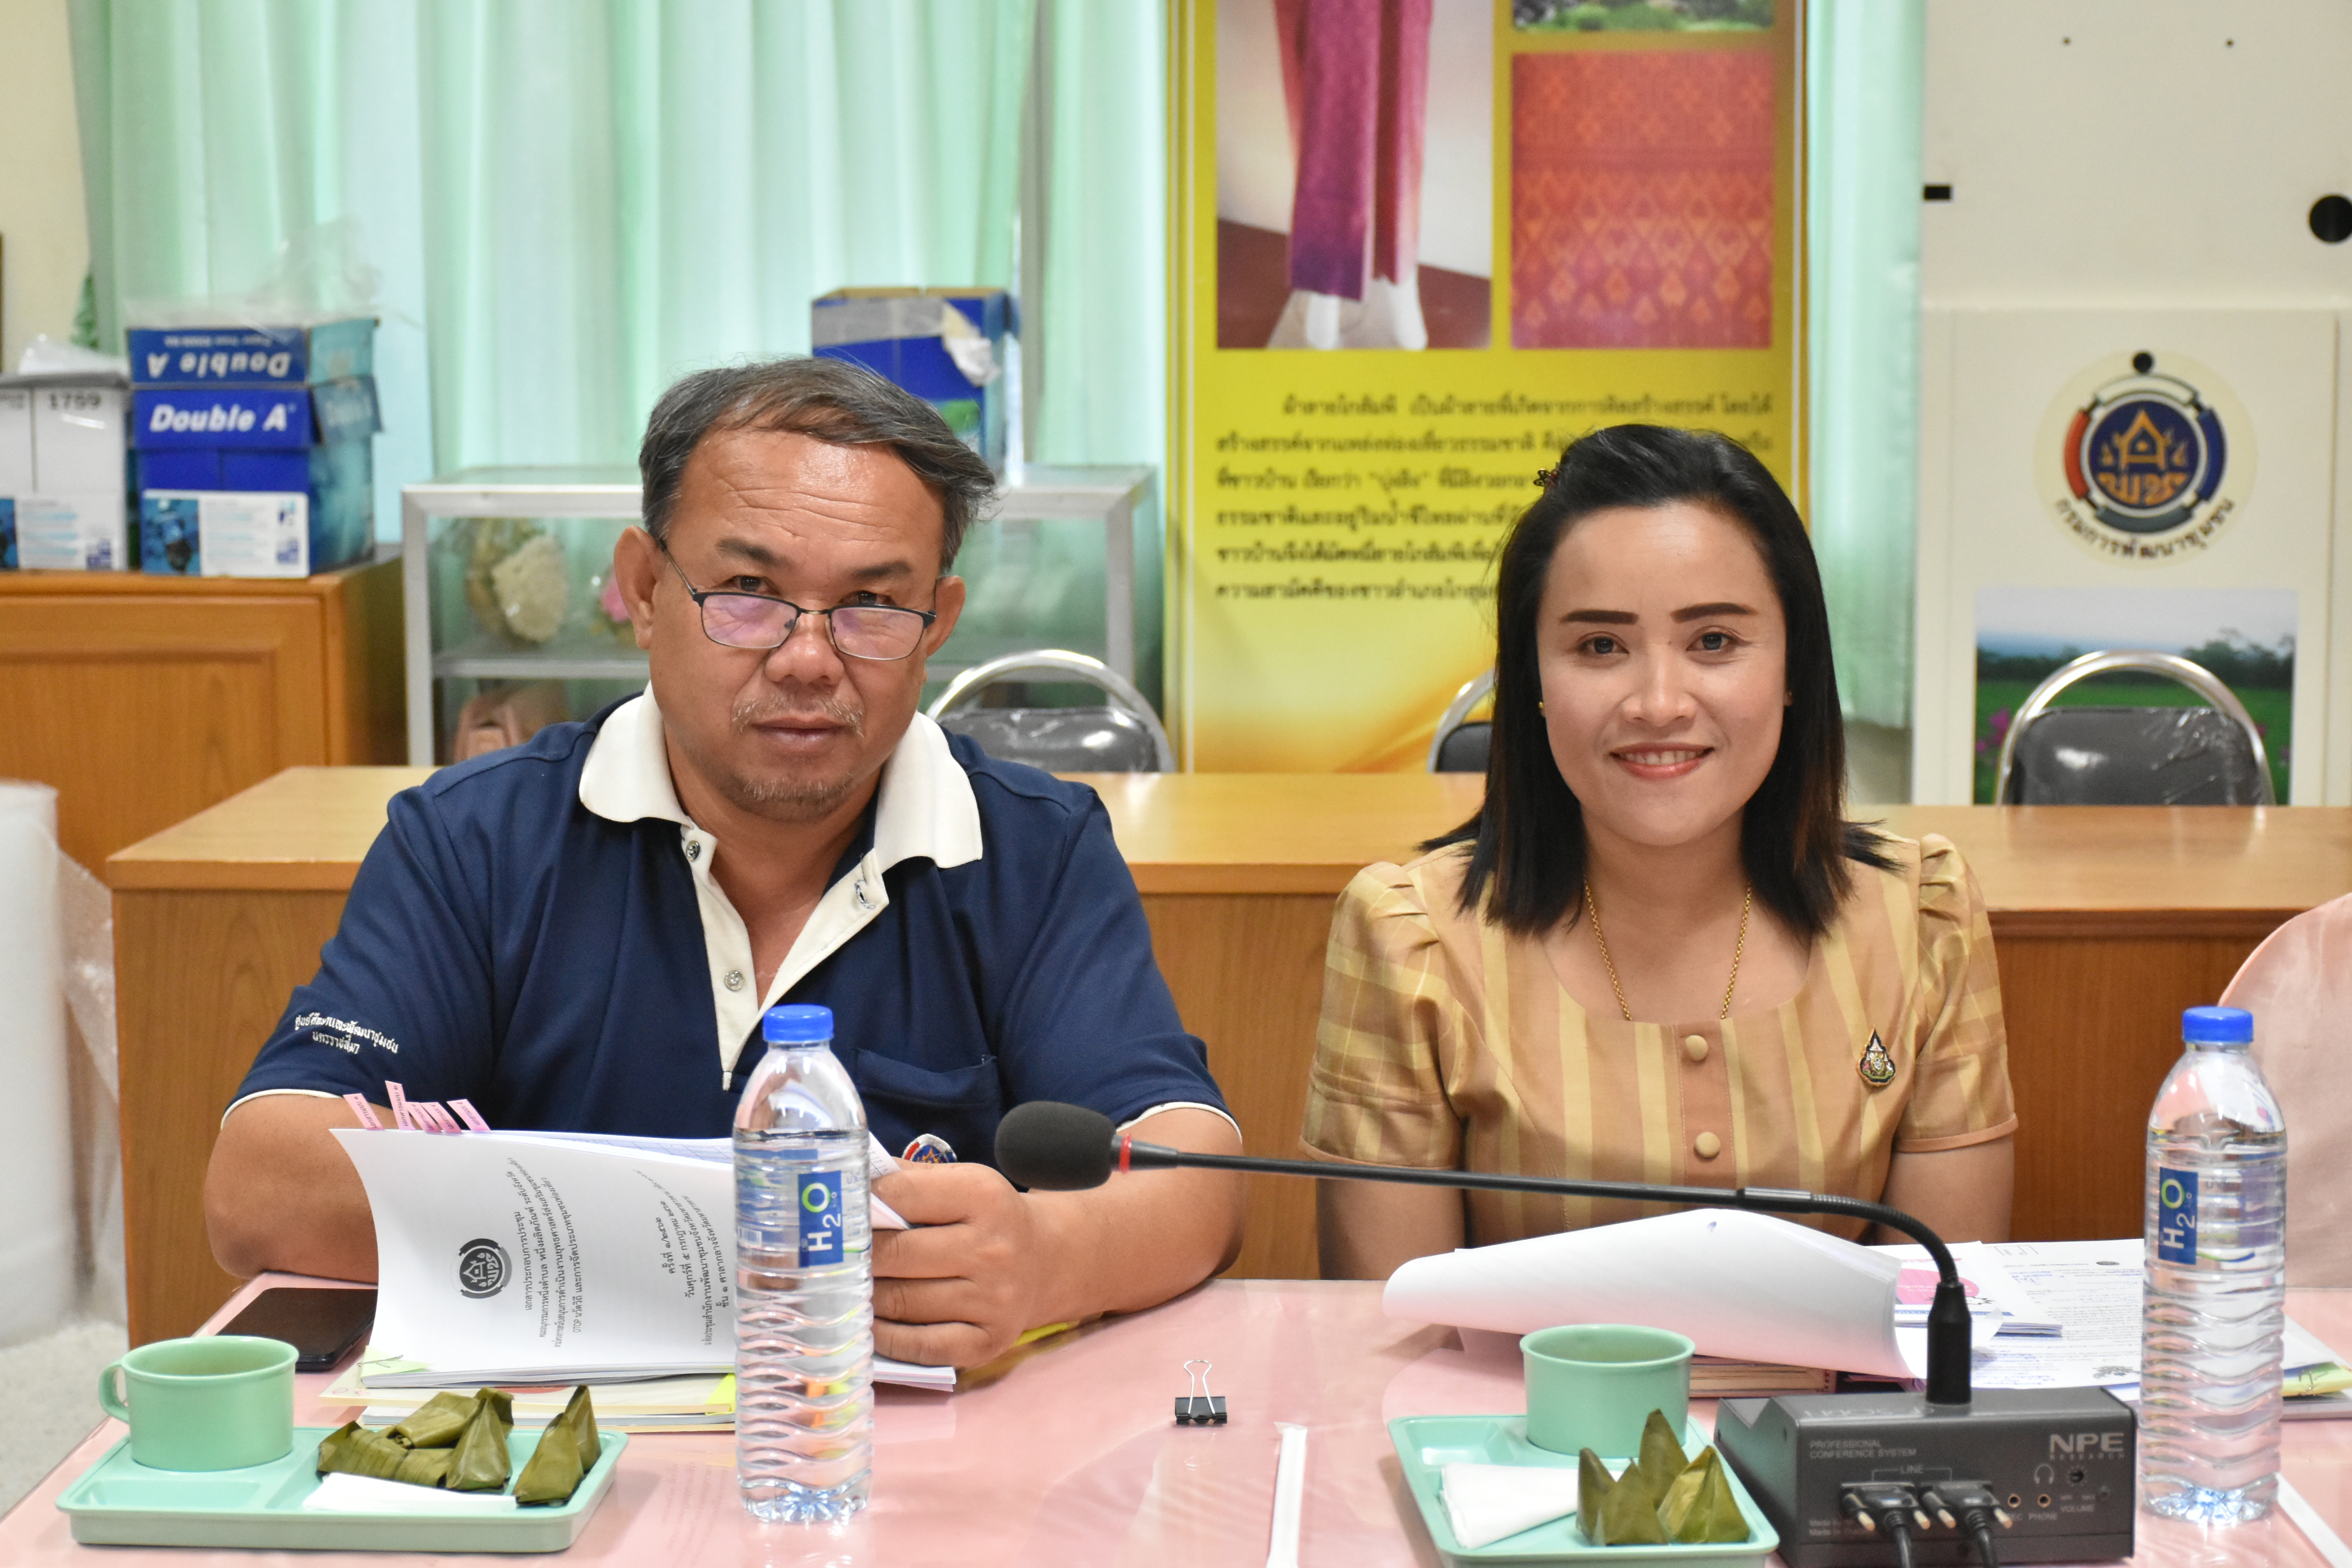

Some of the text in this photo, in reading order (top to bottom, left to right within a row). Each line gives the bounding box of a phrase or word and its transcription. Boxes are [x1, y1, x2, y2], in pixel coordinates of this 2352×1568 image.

[150, 404, 287, 433] Double A
[506, 1171, 532, 1205] ระดับจังหวัด
[524, 1207, 546, 1261] หนึ่งผลิตภัณฑ์
[655, 1217, 675, 1274] ครั้งที่ ๑/๒๕๖๒
[671, 1218, 688, 1251] กรกฎาคม
[514, 1212, 532, 1310] เอกสารประกอบการประชุม
[679, 1263, 697, 1298] วันศุกร์ที่
[715, 1296, 729, 1308] ชั้น
[573, 1319, 582, 1333] OTOP
[1810, 1439, 1881, 1450] PROFESSIONAL
[1810, 1448, 1917, 1459] CONFERENCE SYSTEM
[2050, 1432, 2125, 1453] NPE
[1900, 1465, 1924, 1474] LINE
